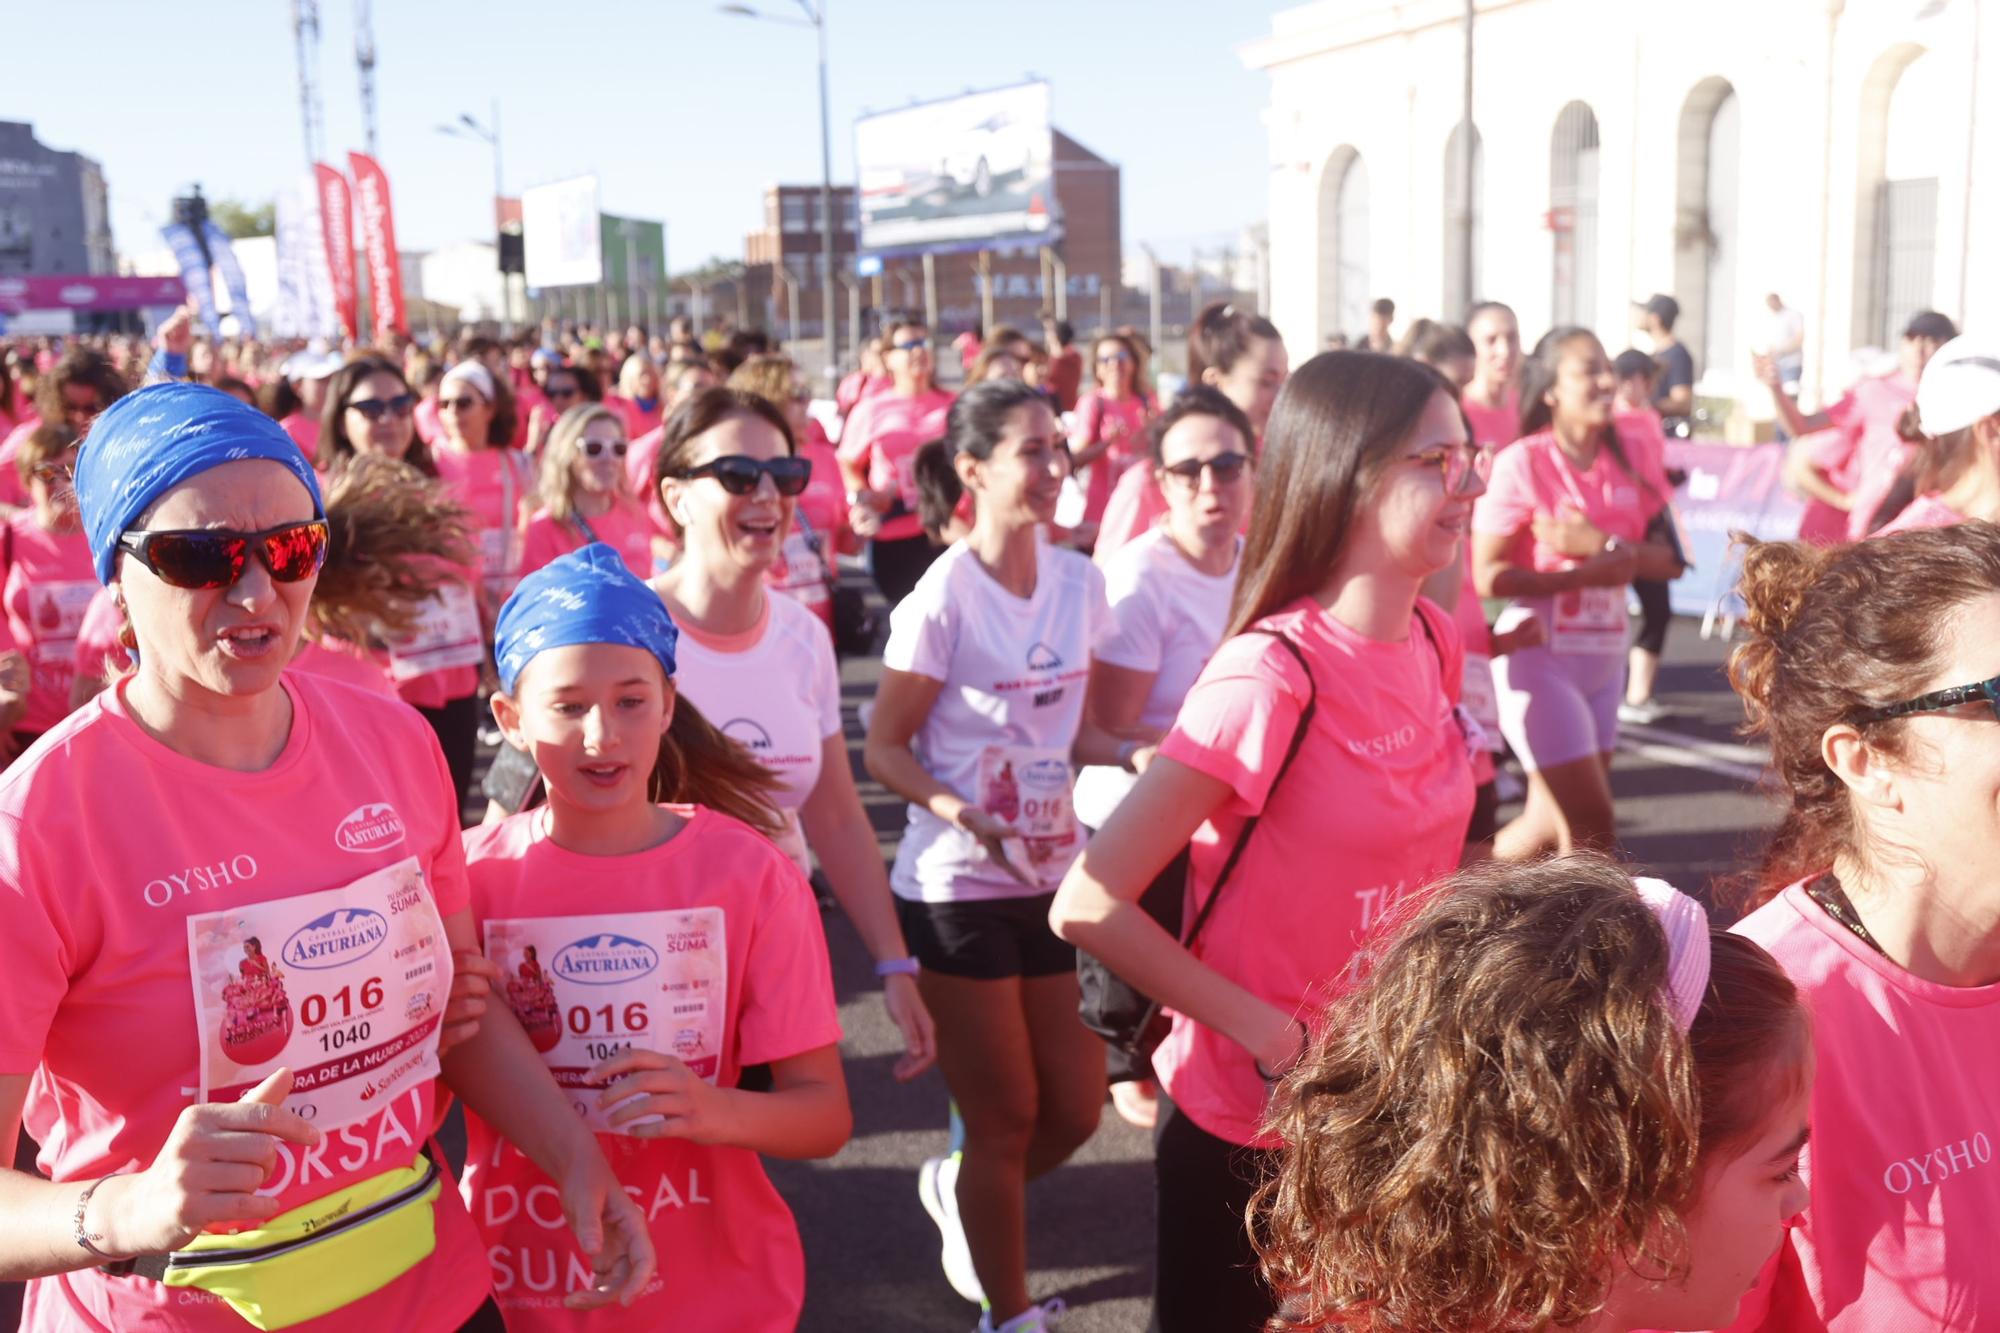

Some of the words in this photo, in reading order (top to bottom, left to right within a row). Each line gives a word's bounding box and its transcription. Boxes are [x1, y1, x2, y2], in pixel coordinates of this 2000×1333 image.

[143, 854, 257, 907] OYSHO
[390, 892, 421, 915] SUMA
[292, 924, 383, 963] ASTURIANA
[667, 938, 709, 953] SUMA
[561, 954, 650, 973] ASTURIANA
[300, 976, 384, 1028] 016
[567, 1002, 649, 1034] 016
[319, 1022, 371, 1052] 1040
[319, 1064, 340, 1081] DE
[343, 1058, 360, 1074] LA
[364, 1039, 404, 1067] MUJER
[378, 1050, 425, 1094] Santander
[1884, 1132, 1992, 1194] OYSHO
